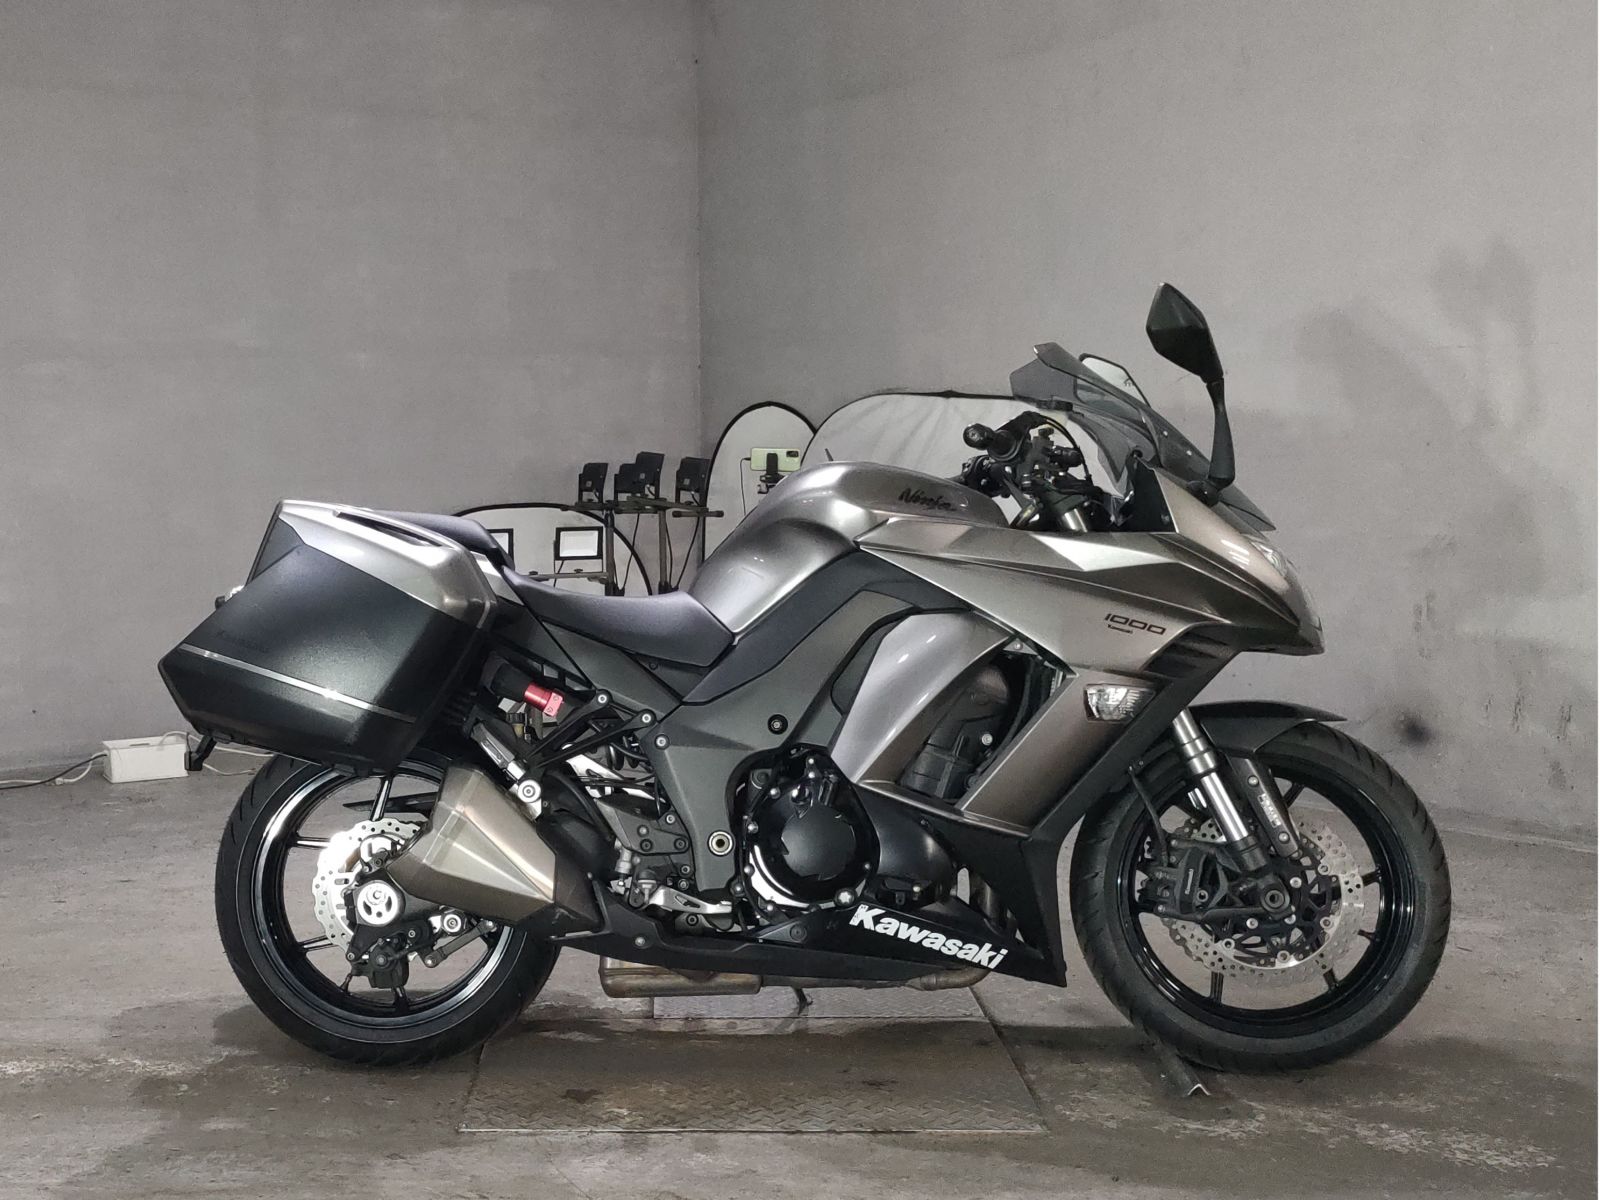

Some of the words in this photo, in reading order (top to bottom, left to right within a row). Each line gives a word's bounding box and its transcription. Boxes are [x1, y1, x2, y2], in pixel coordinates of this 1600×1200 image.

[898, 487, 957, 512] Ninja
[1104, 613, 1167, 635] 1000
[849, 903, 1009, 970] Kawasaki
